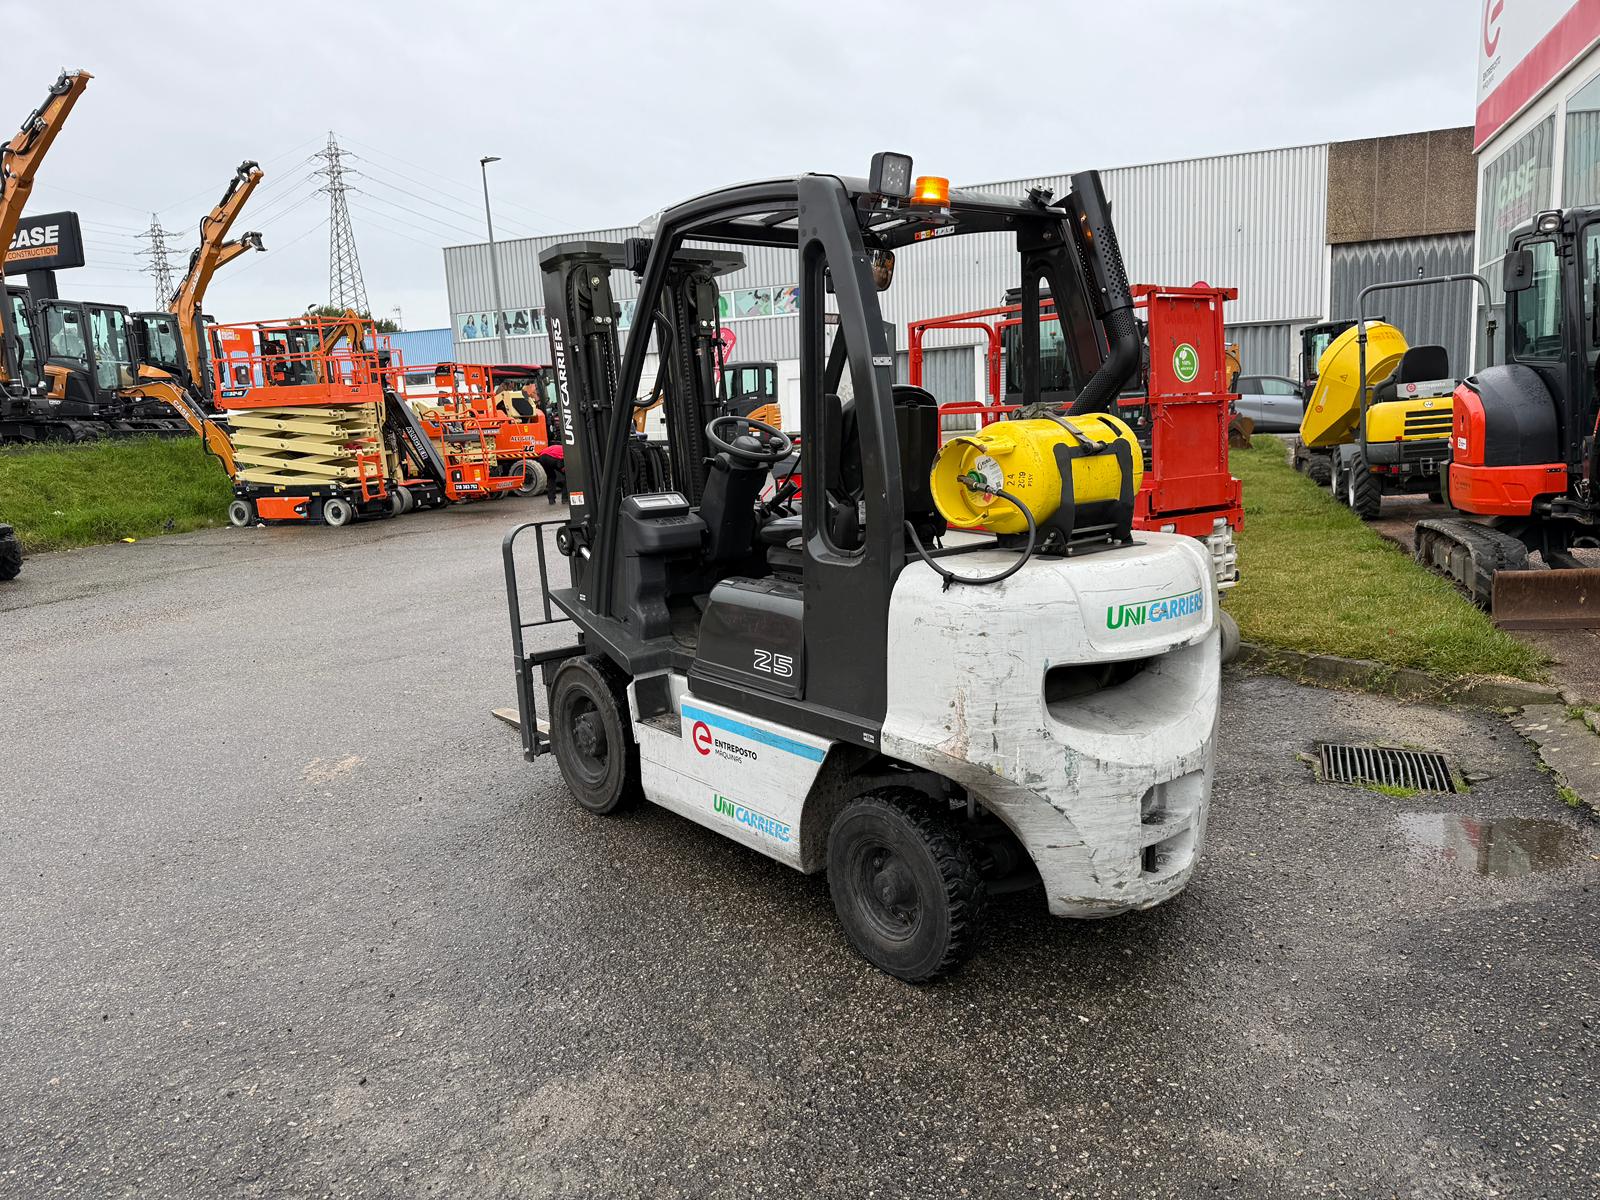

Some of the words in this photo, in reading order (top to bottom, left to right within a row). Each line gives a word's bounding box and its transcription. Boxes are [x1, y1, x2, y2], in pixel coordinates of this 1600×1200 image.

[1497, 156, 1536, 209] CASE
[7, 247, 57, 260] CONSTRUCTION
[405, 426, 429, 460] ALUGUER
[753, 649, 793, 677] 25
[692, 720, 713, 756] e
[714, 738, 758, 760] ENTREPOSTO
